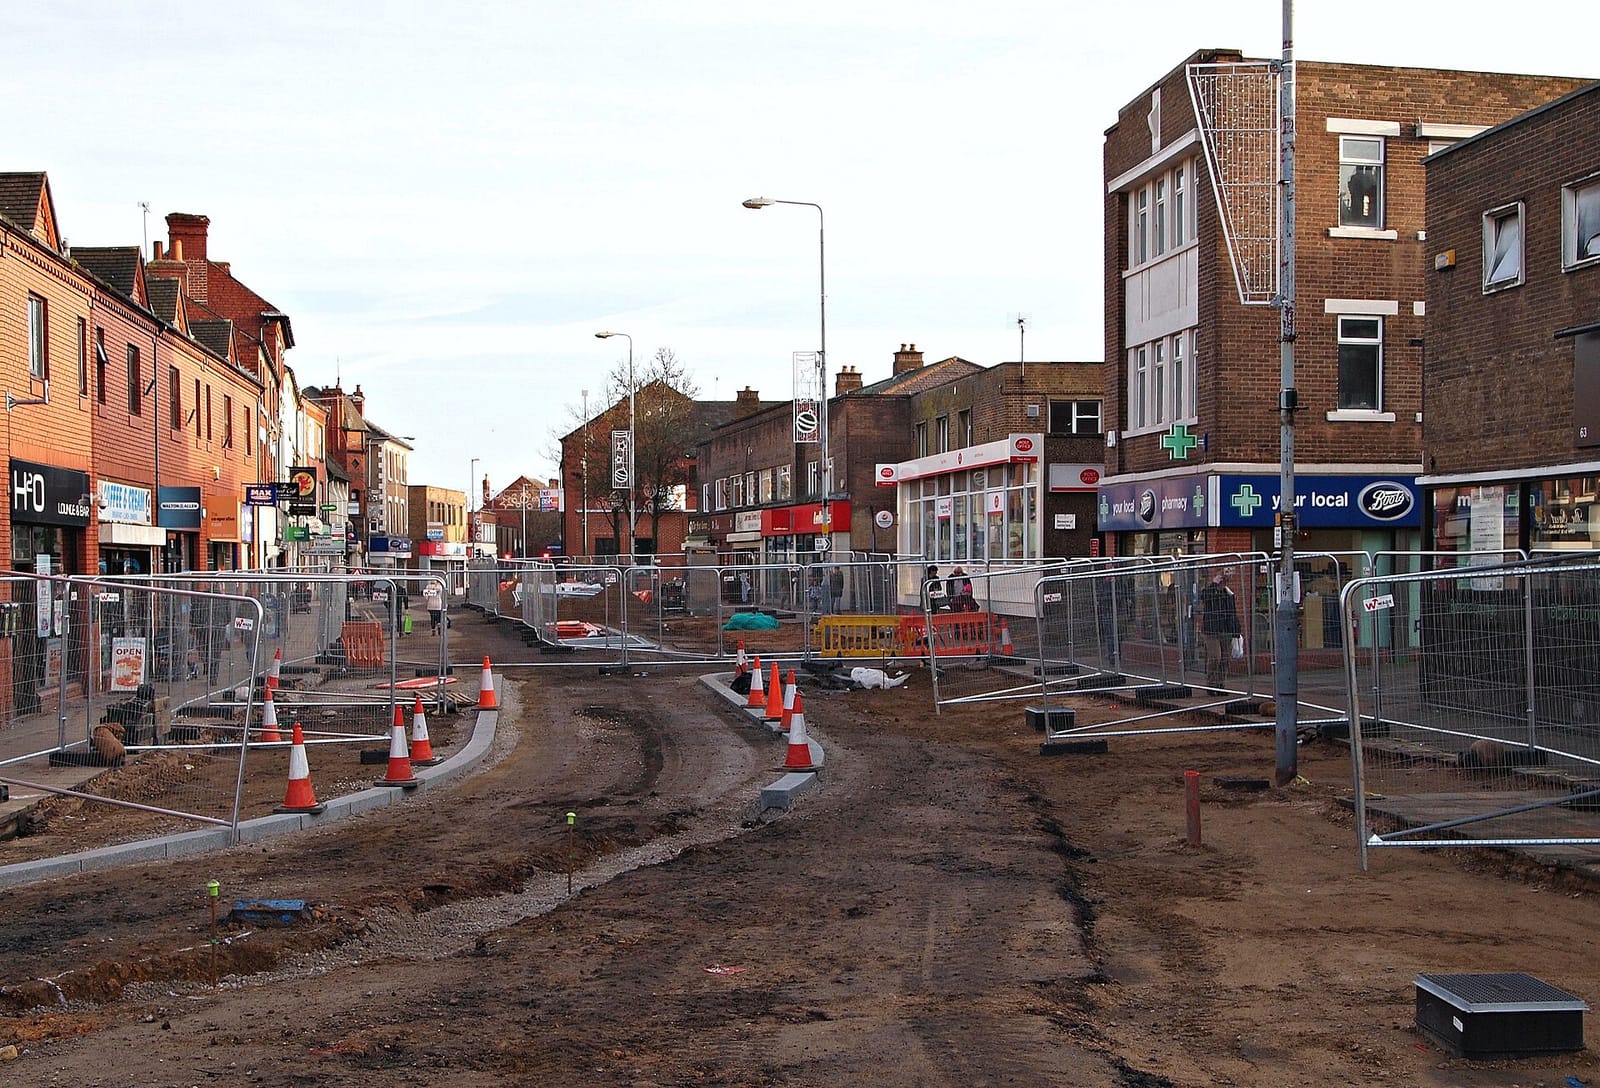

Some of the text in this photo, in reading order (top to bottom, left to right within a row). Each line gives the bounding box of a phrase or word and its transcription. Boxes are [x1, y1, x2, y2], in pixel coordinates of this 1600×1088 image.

[1112, 499, 1135, 516] your local
[1161, 496, 1188, 512] pharmacy
[1272, 491, 1348, 510] yur local
[1368, 489, 1405, 511] Boots
[57, 502, 75, 516] LOUNGE
[79, 505, 90, 517] BAR
